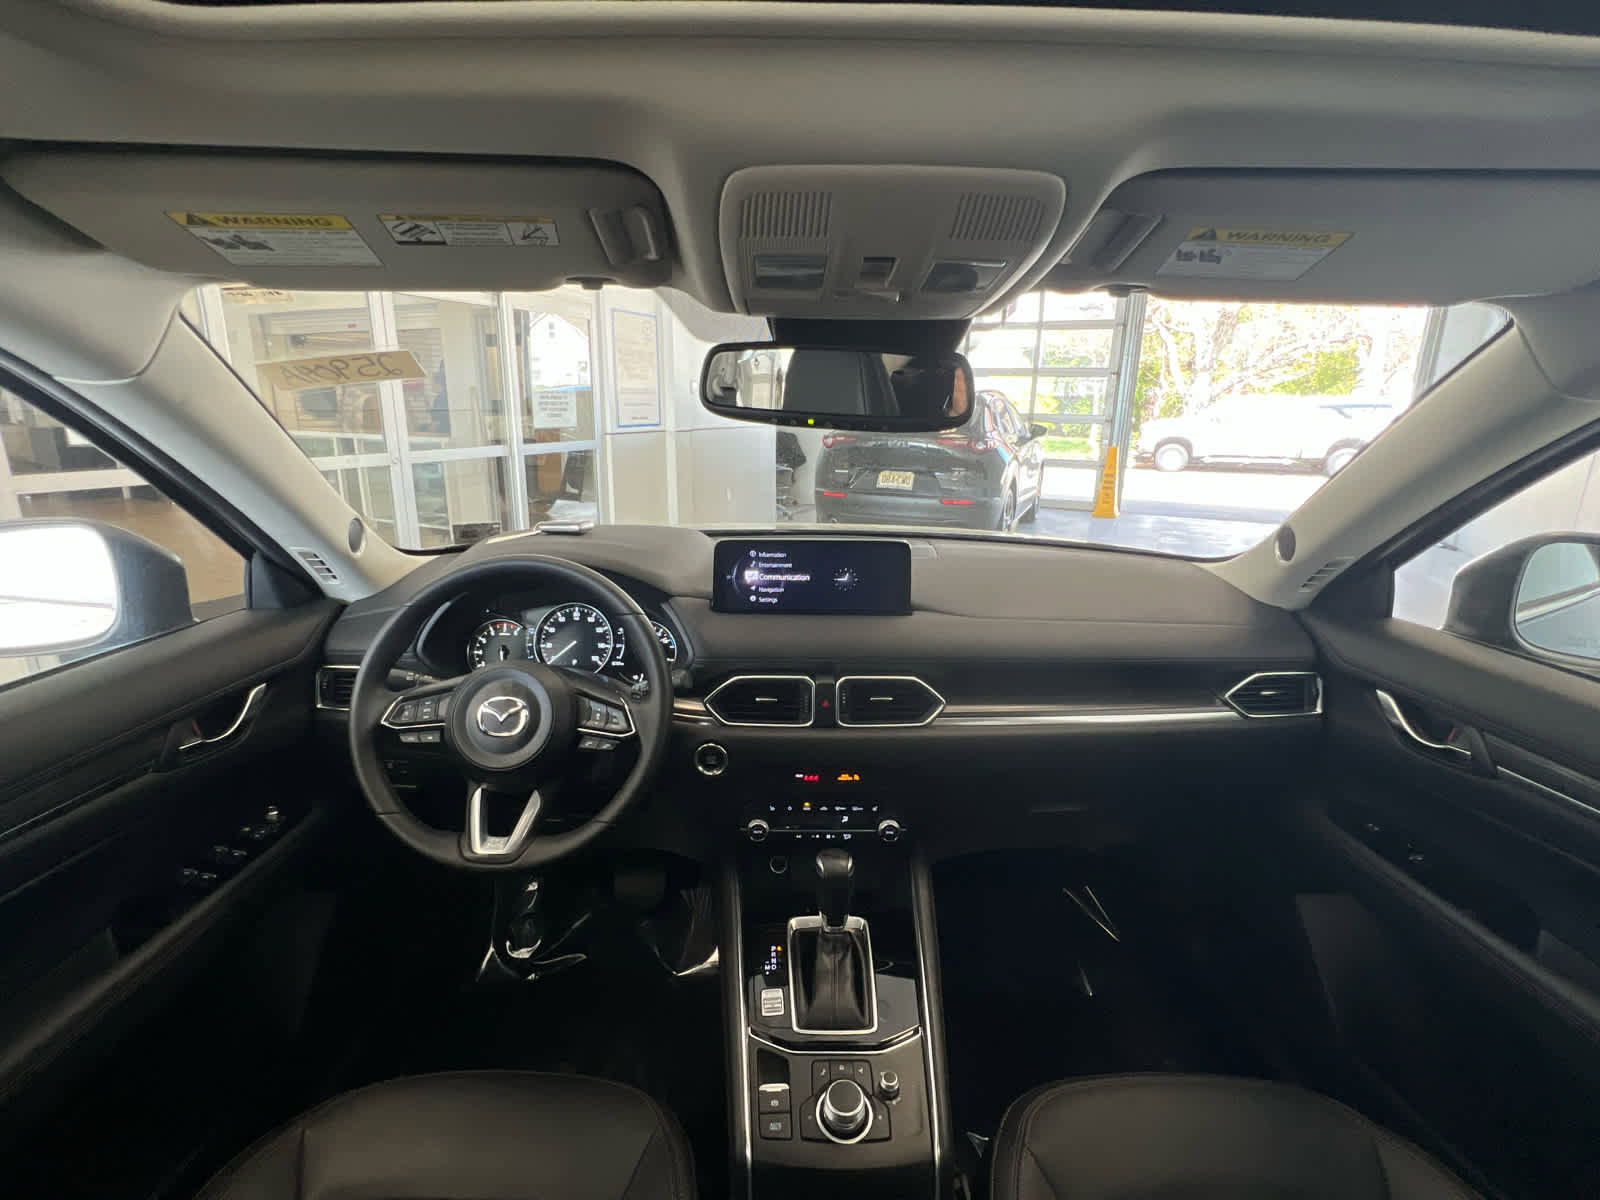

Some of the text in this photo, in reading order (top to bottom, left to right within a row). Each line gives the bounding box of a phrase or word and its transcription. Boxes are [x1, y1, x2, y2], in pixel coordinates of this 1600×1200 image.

[216, 214, 333, 227] WARNING
[1227, 231, 1331, 243] WARNING
[759, 573, 810, 581] Communication
